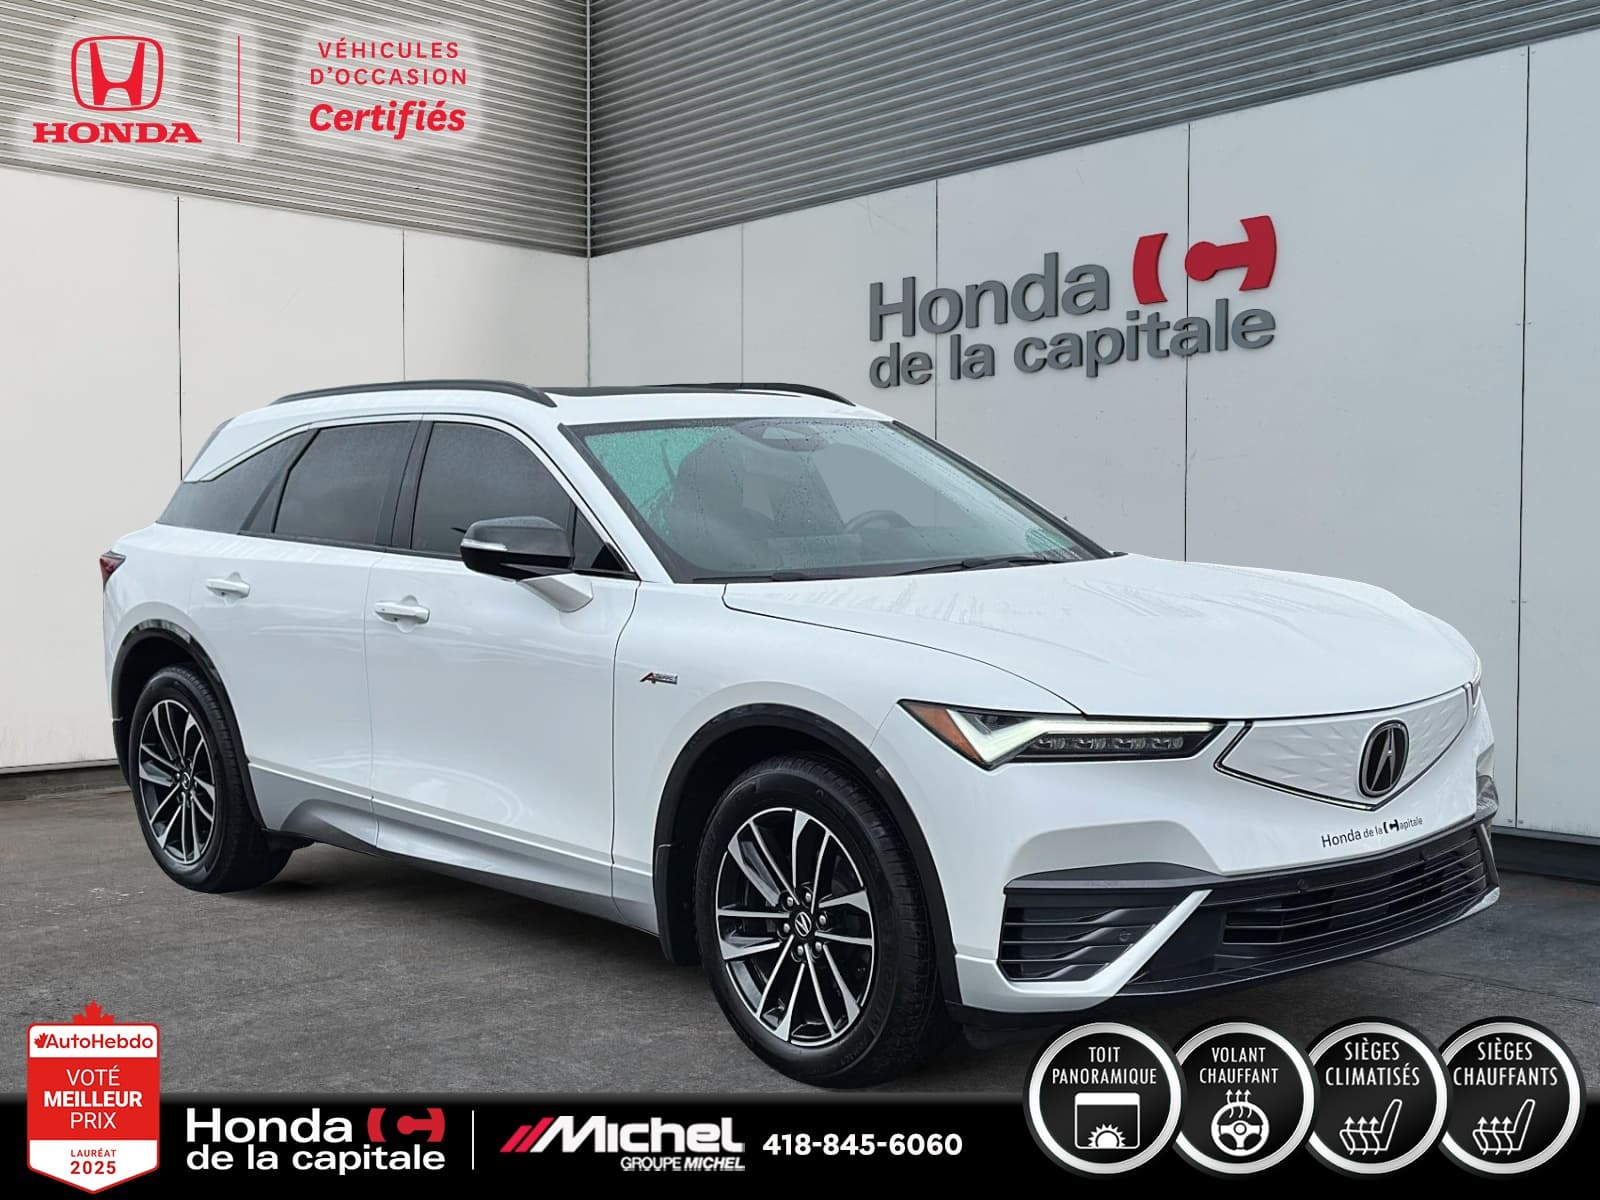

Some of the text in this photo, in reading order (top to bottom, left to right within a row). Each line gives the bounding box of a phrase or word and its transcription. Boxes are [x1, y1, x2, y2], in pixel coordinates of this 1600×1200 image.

[869, 251, 1110, 342] Honda
[869, 297, 1277, 388] de la capitale
[1321, 829, 1362, 848] Honda
[1363, 828, 1374, 838] de
[1375, 825, 1383, 835] la
